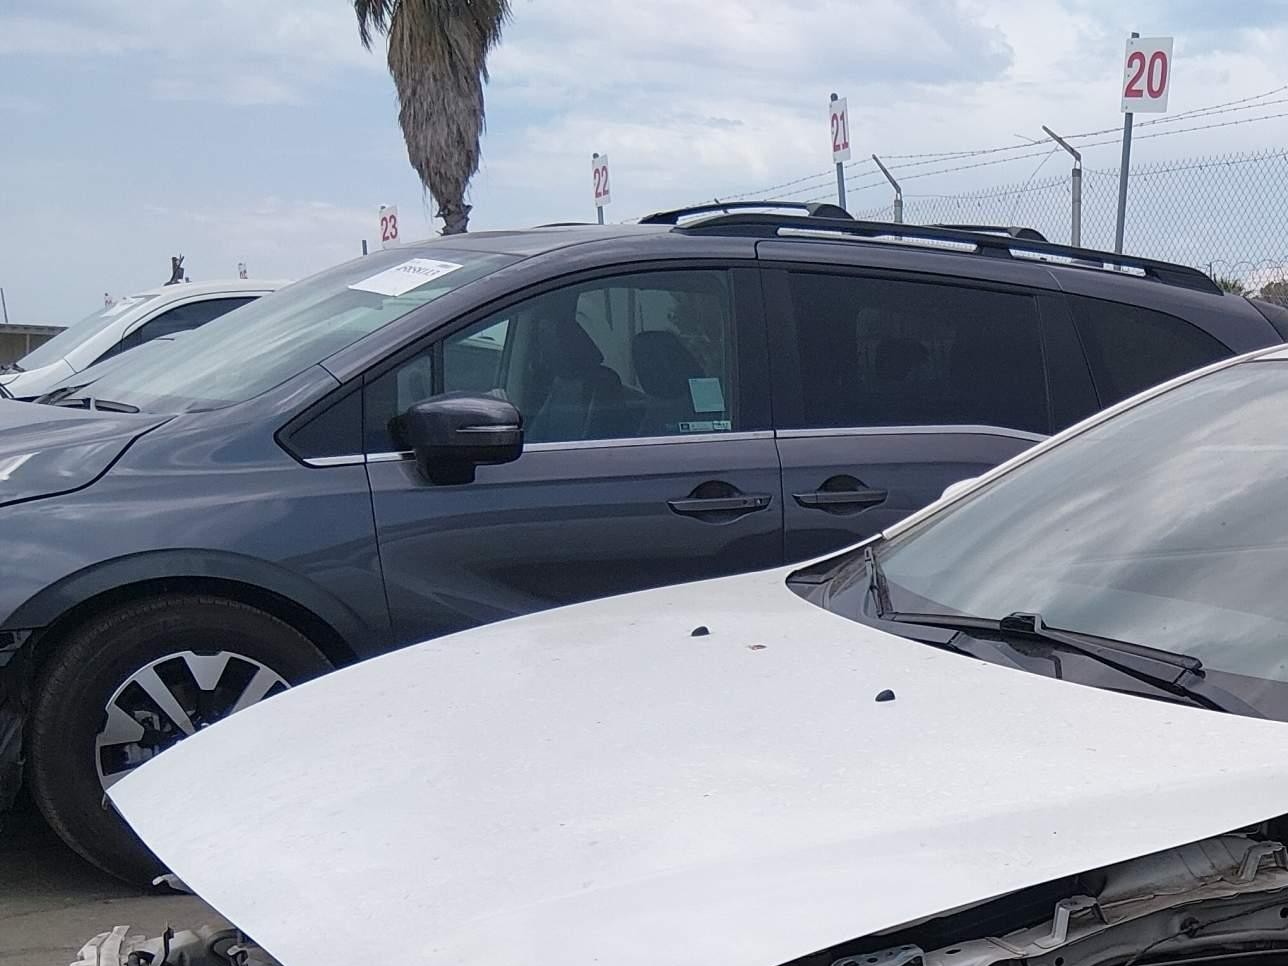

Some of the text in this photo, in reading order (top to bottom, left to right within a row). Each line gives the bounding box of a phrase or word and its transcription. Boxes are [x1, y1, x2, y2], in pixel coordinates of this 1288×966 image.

[1124, 50, 1168, 99] 20
[831, 111, 849, 152] 21
[593, 165, 609, 198] 22
[380, 214, 398, 242] 23
